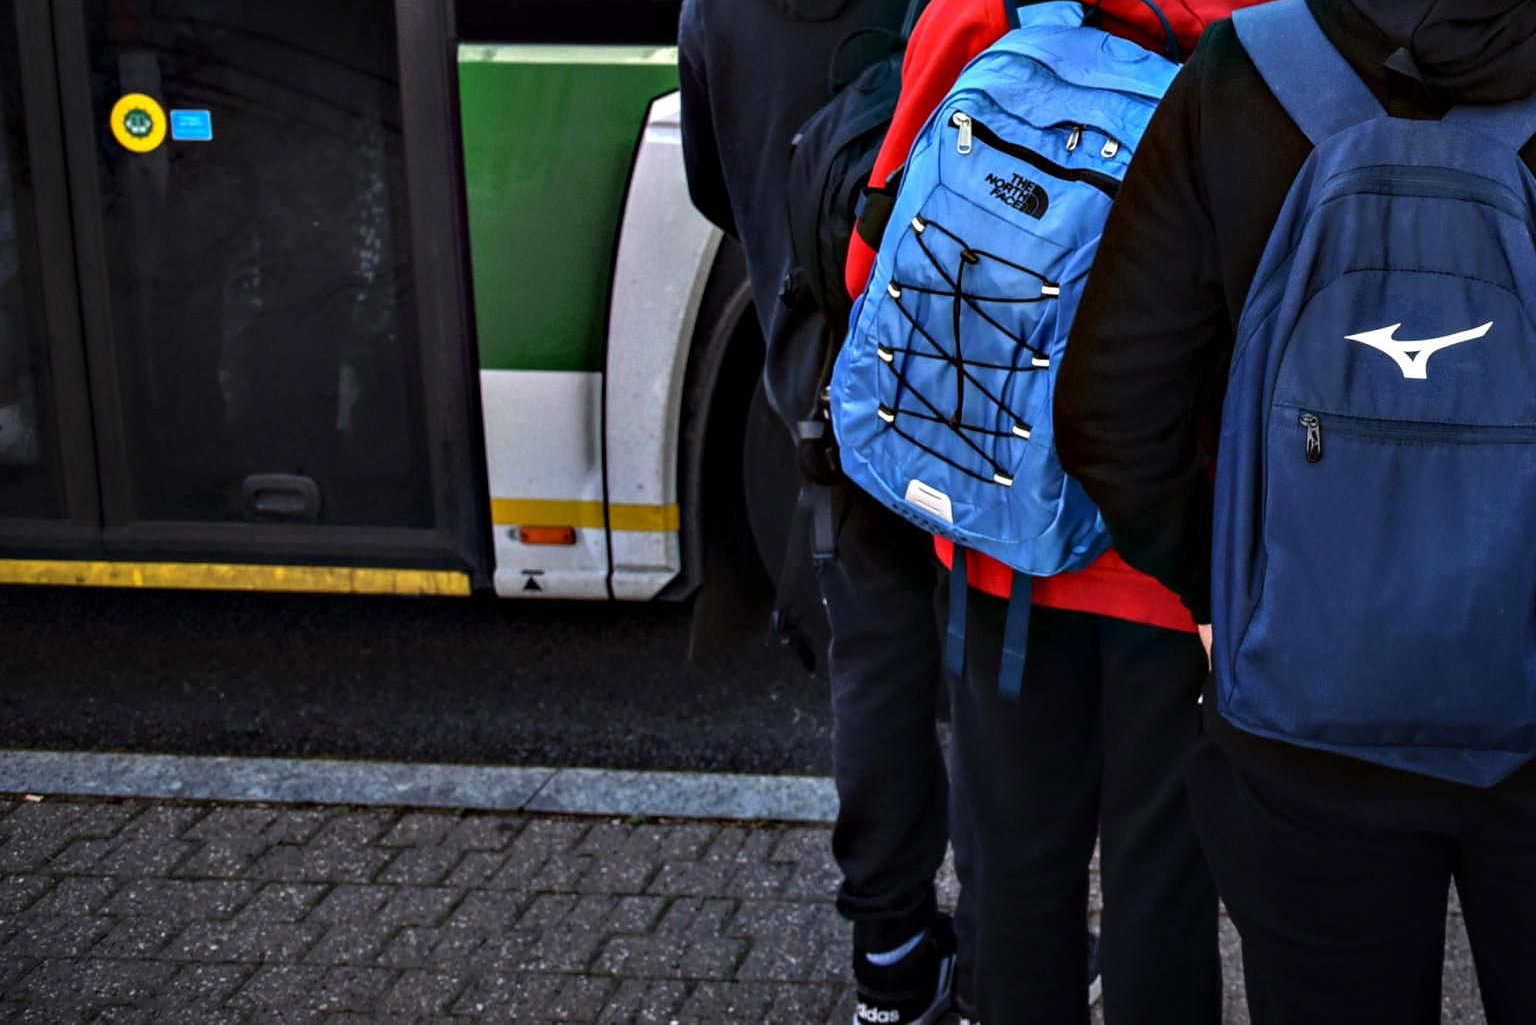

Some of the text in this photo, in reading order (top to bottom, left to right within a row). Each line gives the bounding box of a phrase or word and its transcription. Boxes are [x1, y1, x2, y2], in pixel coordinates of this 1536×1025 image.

[984, 172, 1028, 203] NORTH
[1010, 172, 1036, 193] THE
[989, 187, 1025, 210] FACE
